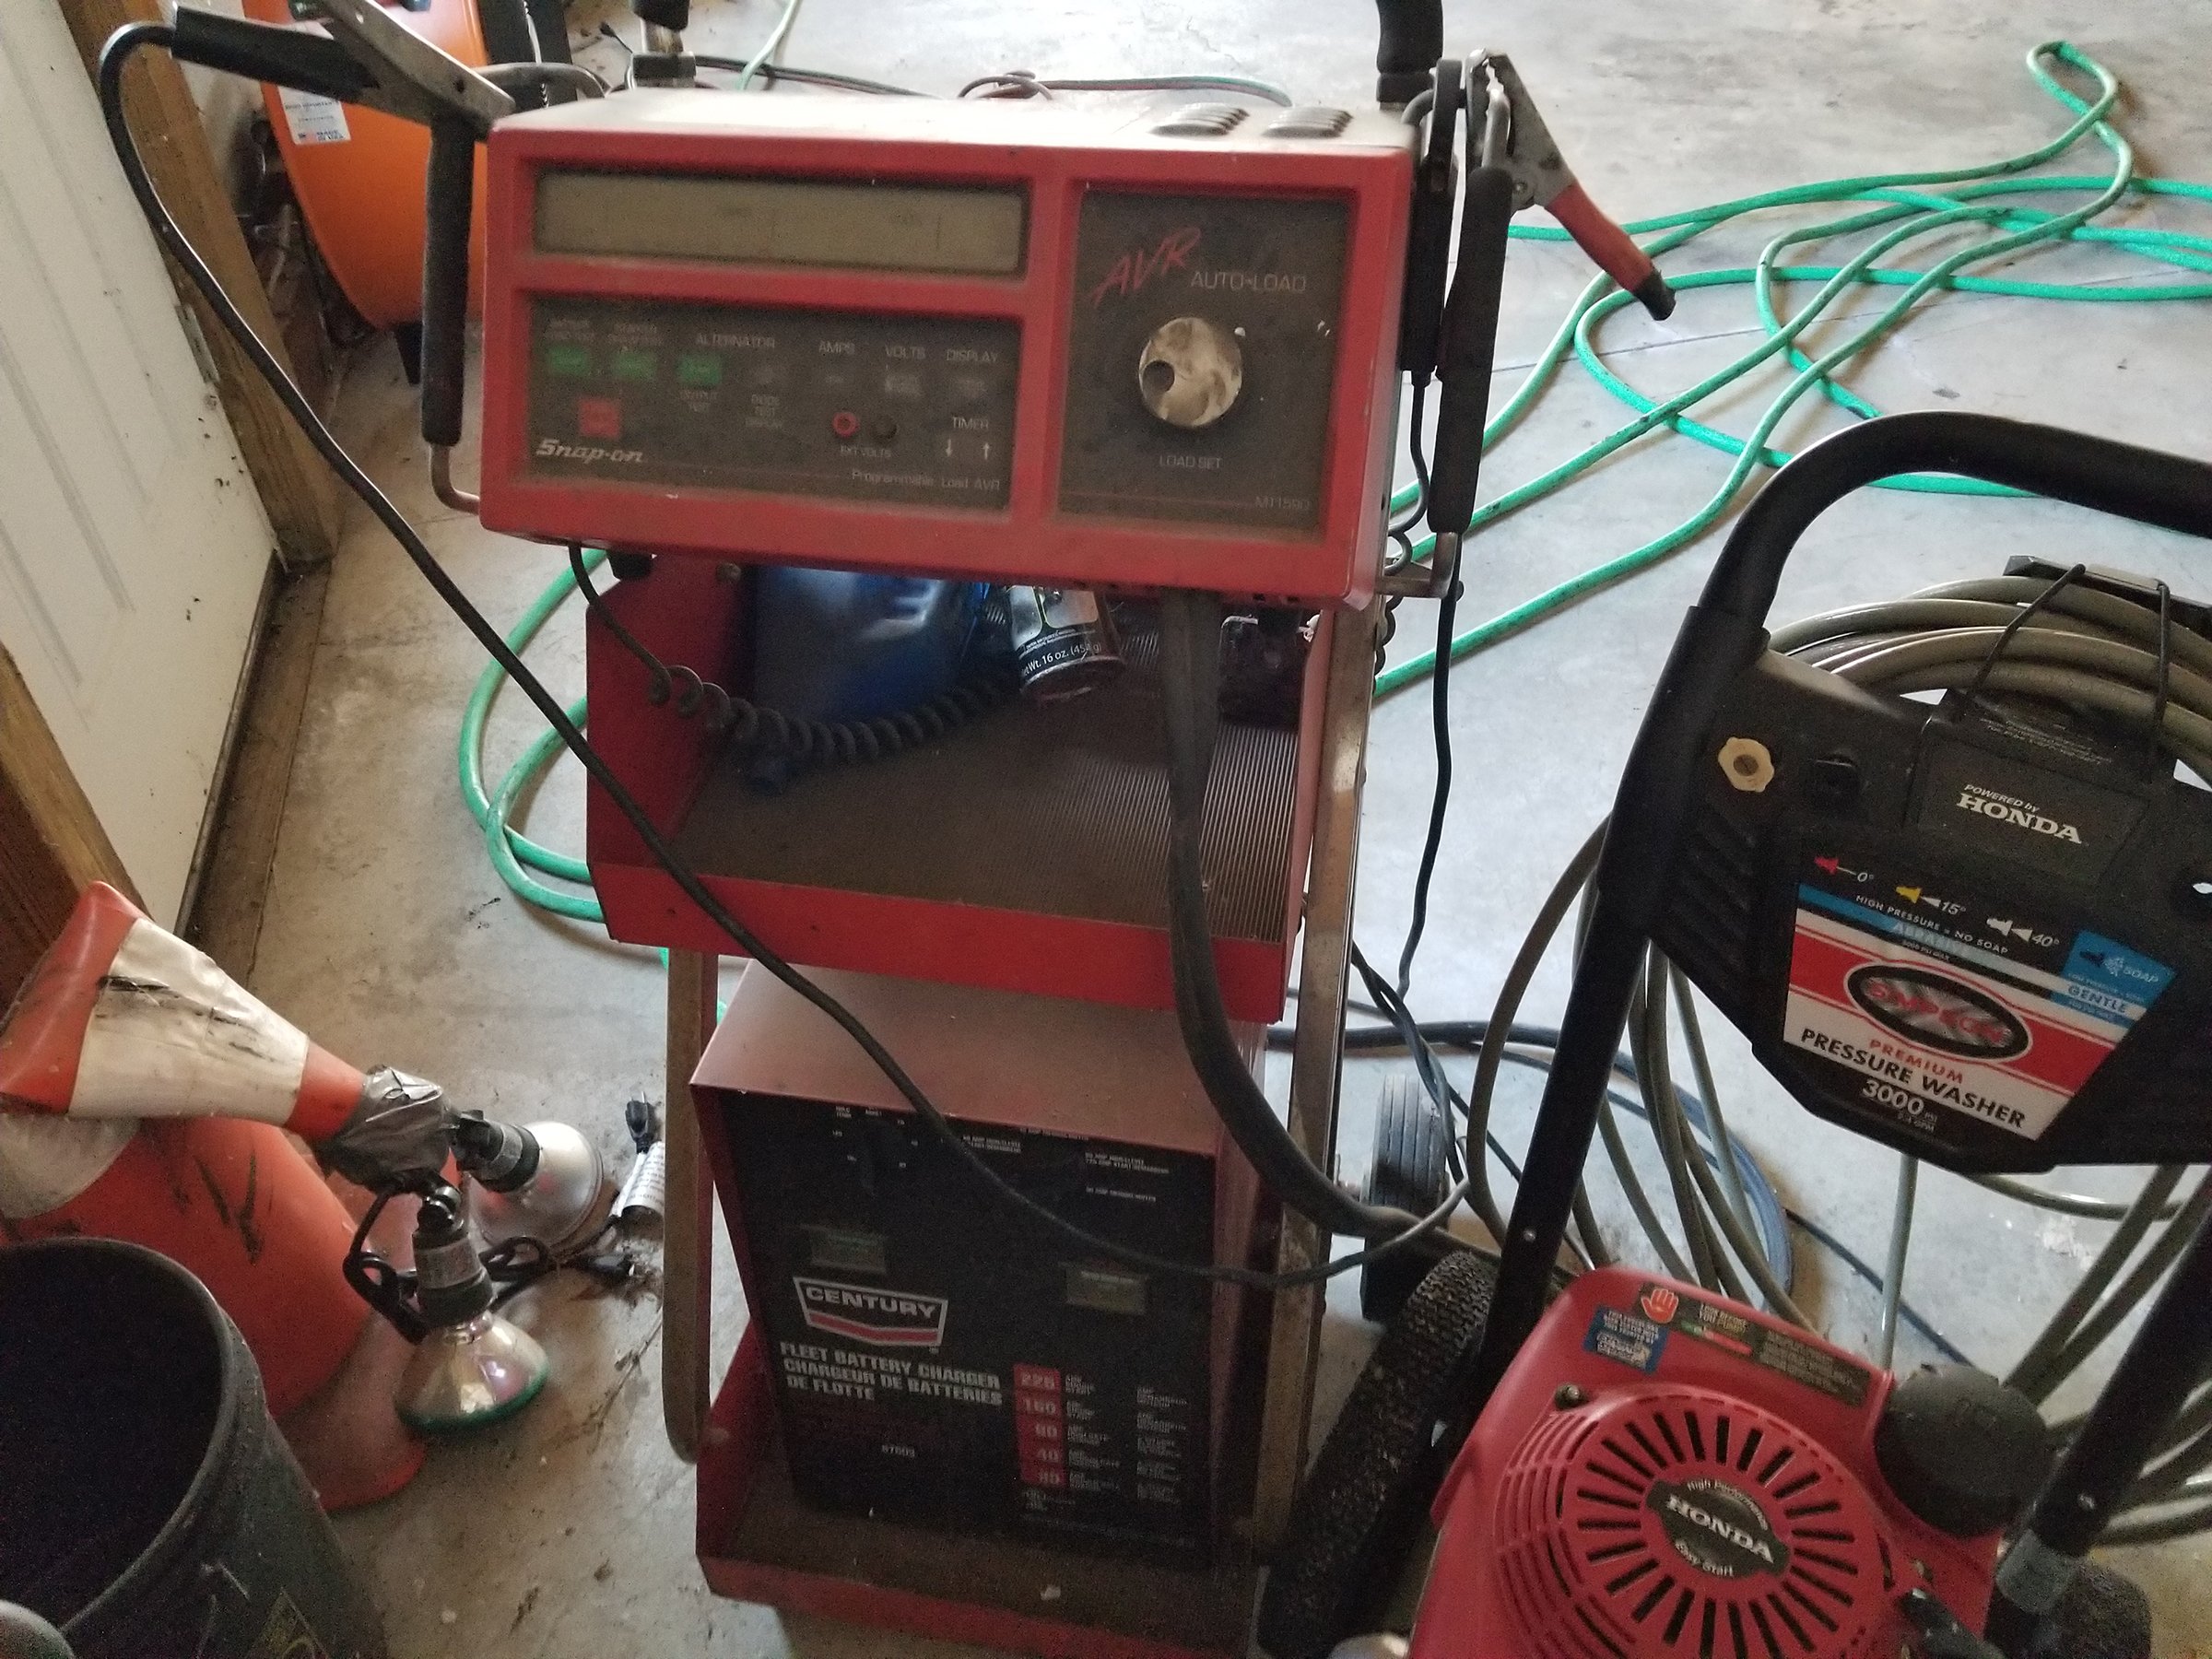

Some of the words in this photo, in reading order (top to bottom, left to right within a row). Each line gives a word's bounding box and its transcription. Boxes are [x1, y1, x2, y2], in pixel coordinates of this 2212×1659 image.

[1091, 228, 1202, 307] AVR
[1191, 271, 1307, 293] AUTO-LOAD
[695, 333, 775, 349] ALTERNATOR
[818, 340, 855, 356] AMPS
[885, 345, 926, 359] VOLTS
[947, 348, 1000, 363] DISPLAY
[952, 416, 989, 430] TIMER
[535, 438, 643, 465] Snap-on
[1159, 454, 1196, 468] LOAD
[1198, 456, 1222, 470] SET
[852, 468, 935, 487] Programmable
[941, 477, 970, 489] Load
[973, 477, 1001, 491] AVR
[1028, 659, 1041, 672] Wt.
[1041, 652, 1054, 665] 16
[1054, 649, 1069, 661] oz.
[1964, 783, 2024, 807] POWERED
[1956, 793, 2083, 844] HONDA
[1855, 894, 1884, 912] HIGH
[1887, 906, 1941, 932] PRESSURE
[1954, 929, 1974, 943] NO
[1976, 937, 2009, 956] SOAP
[2122, 968, 2160, 983] SOAP
[2067, 983, 2127, 1013] GENTLE
[1869, 1038, 1964, 1085] PREMIUM
[1800, 1028, 1914, 1085] PRESSURE
[1922, 1074, 2027, 1130] WASHER
[1862, 1077, 1926, 1116] 3000
[806, 1286, 936, 1320] CENTURY
[781, 1341, 829, 1363] FLEET
[834, 1349, 912, 1374] BATTERY
[918, 1362, 1001, 1390] CHARGER
[784, 1358, 876, 1386] CHARGEUR
[880, 1373, 904, 1390] DE
[786, 1374, 808, 1389] DE
[813, 1377, 876, 1401] FLOTTE
[1687, 1478, 1712, 1491] High
[1666, 1493, 1774, 1564] HONDA
